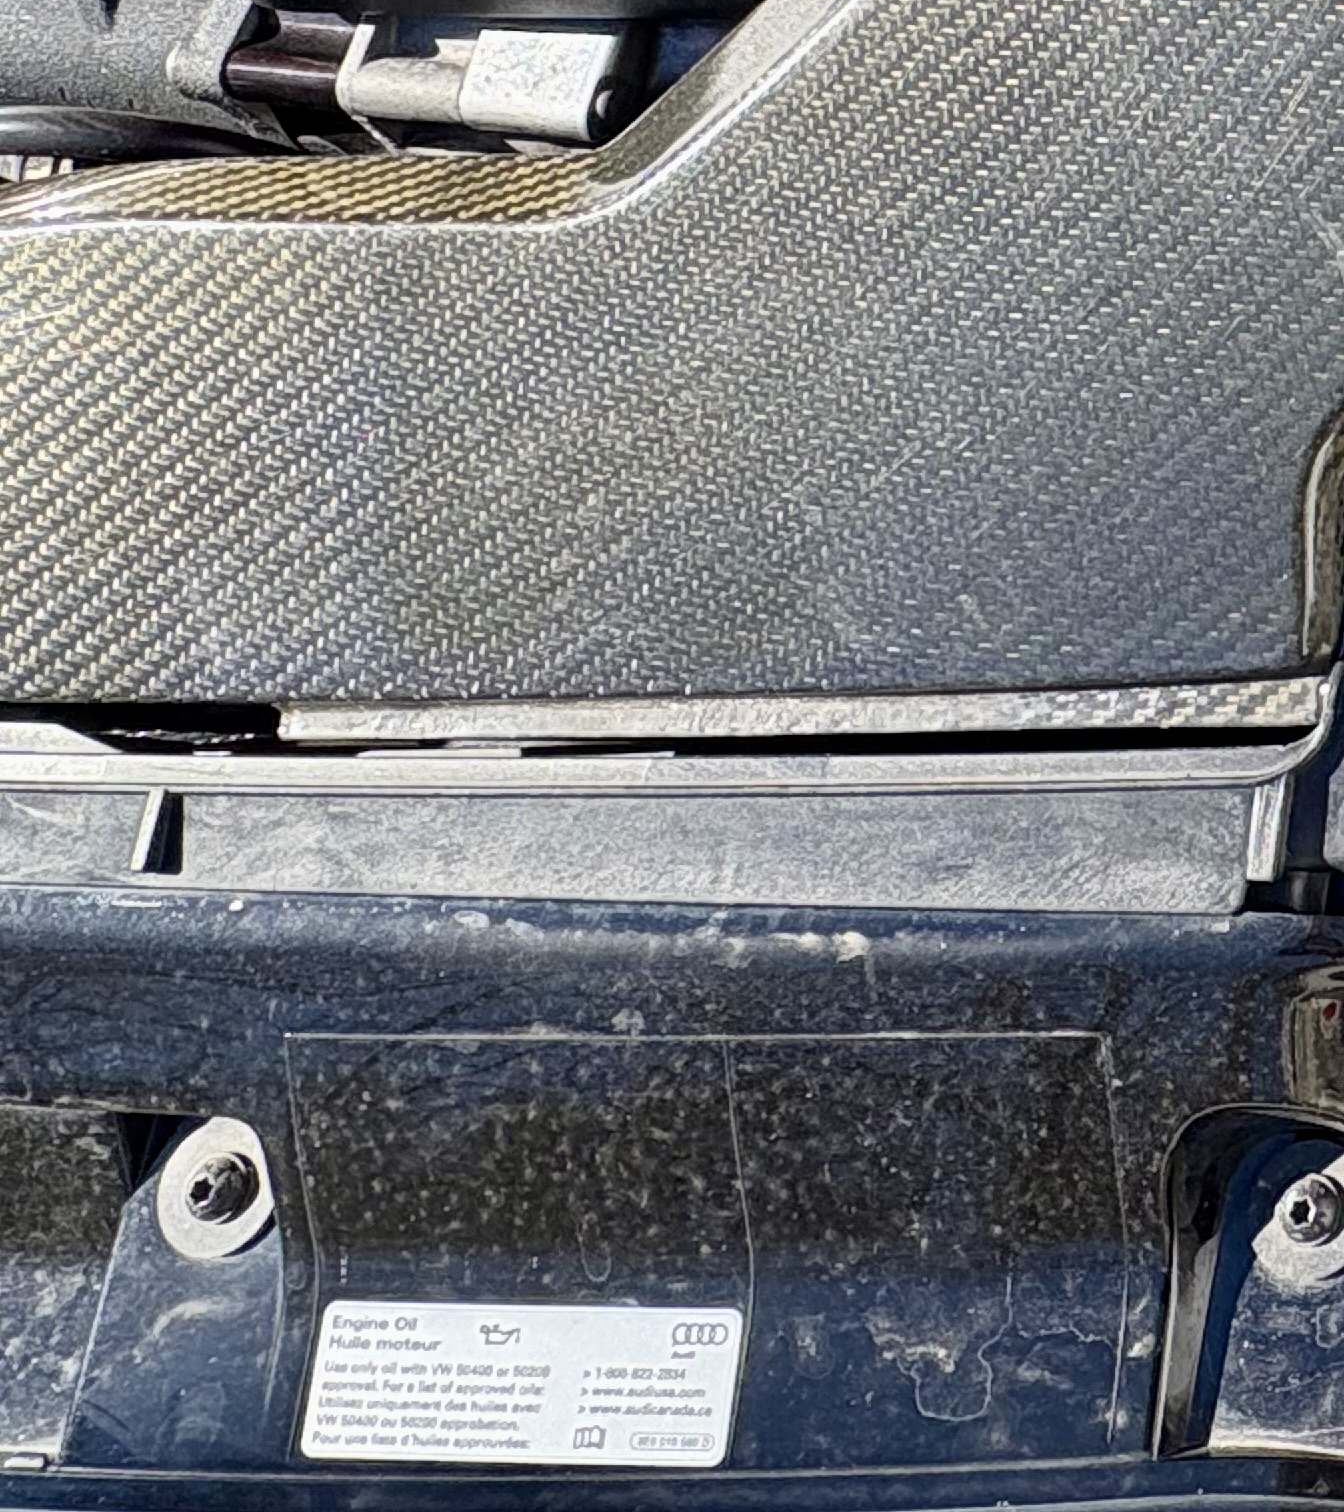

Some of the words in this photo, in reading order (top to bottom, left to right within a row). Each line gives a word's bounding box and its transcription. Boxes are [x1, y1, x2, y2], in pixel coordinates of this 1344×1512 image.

[332, 1314, 389, 1332] Engine
[394, 1316, 418, 1331] Oil
[328, 1334, 371, 1349] Huile
[375, 1338, 442, 1351] moteur
[325, 1360, 347, 1372] Use
[351, 1360, 377, 1375] only
[381, 1361, 397, 1374] oil
[401, 1363, 427, 1375] with
[432, 1363, 453, 1376] VW
[497, 1368, 509, 1377] or
[383, 1379, 404, 1392] For
[407, 1383, 415, 1393] a
[418, 1380, 437, 1393] list
[440, 1380, 454, 1393] of
[456, 1383, 516, 1396] approved
[445, 1399, 467, 1412] des
[471, 1400, 507, 1413] huiles
[317, 1413, 338, 1426] VW
[381, 1418, 397, 1428] ou
[312, 1431, 341, 1443] Pour
